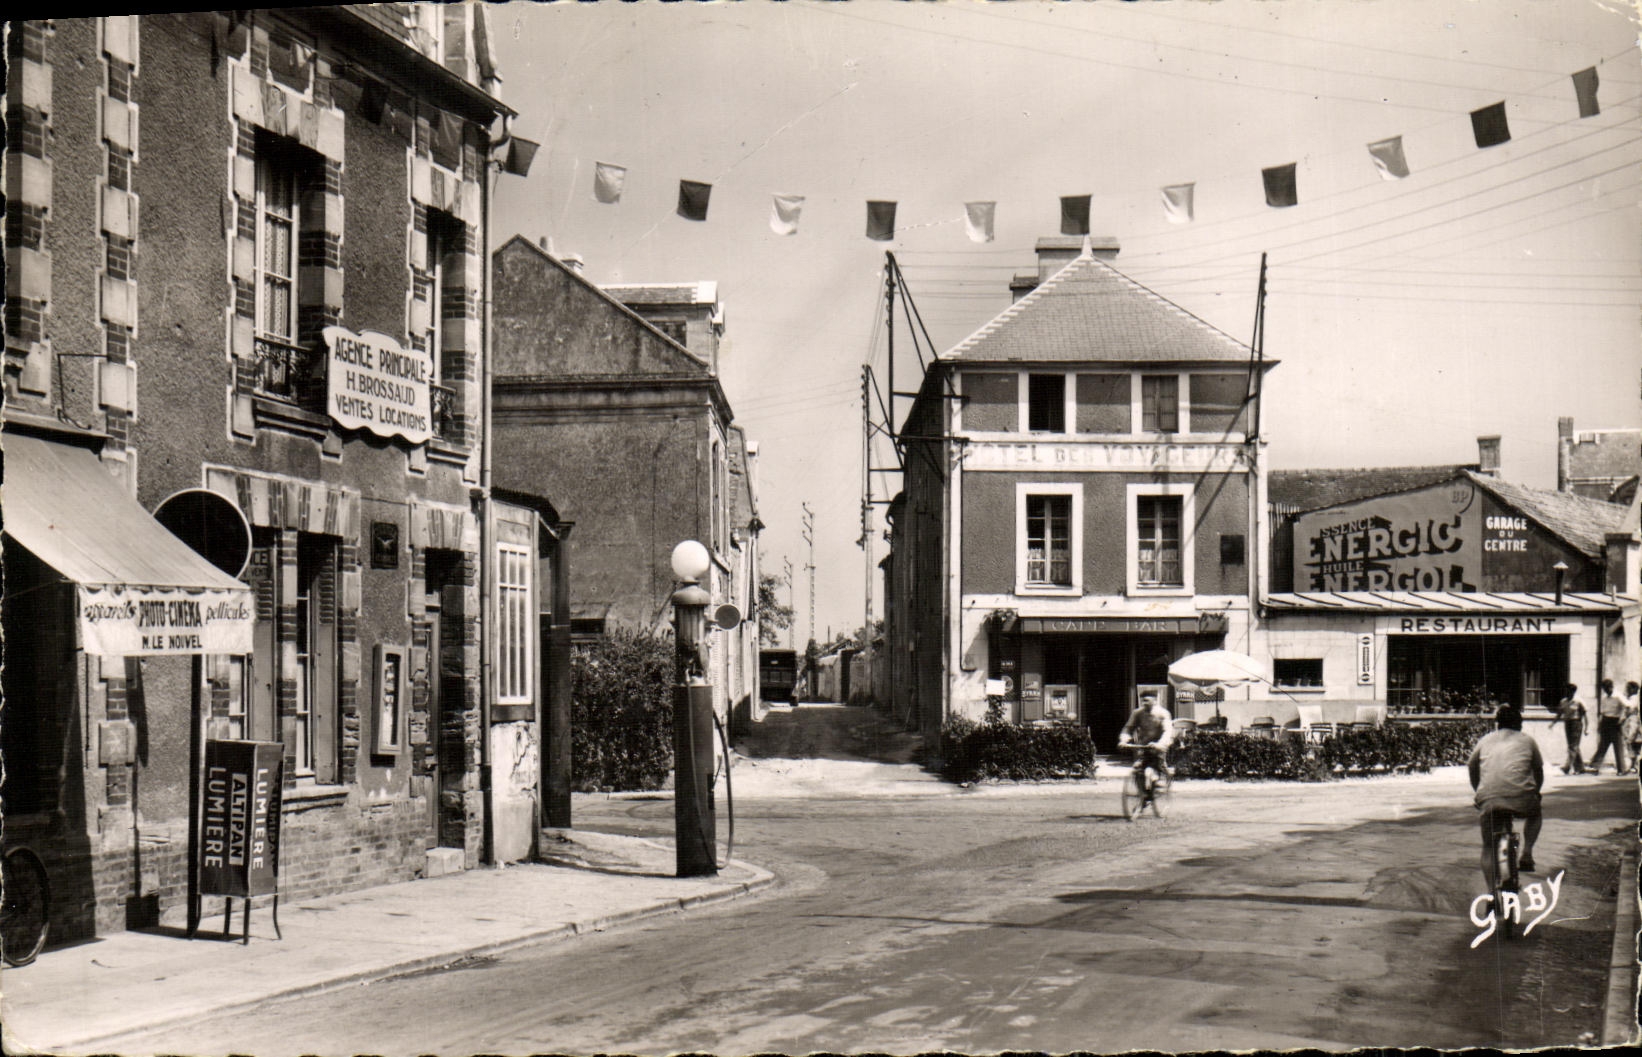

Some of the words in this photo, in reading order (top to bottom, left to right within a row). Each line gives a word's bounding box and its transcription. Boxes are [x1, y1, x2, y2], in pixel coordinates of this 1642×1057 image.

[335, 336, 373, 369] AGENCE
[379, 348, 426, 384] PRINCIPALE
[335, 393, 374, 420] VENTES
[379, 404, 427, 433] LOCATIONS
[1485, 516, 1528, 530] GARAGE
[1499, 530, 1514, 539] DU
[1304, 514, 1463, 563] ENERGIC
[1484, 539, 1528, 552] CENTRE
[1304, 564, 1464, 592] ENERGOL
[1323, 560, 1364, 575] HUILE
[205, 601, 250, 624] pellicules
[1125, 620, 1169, 632] BAR
[1401, 617, 1557, 632] RESTAURANT
[169, 635, 203, 649] NOUVEL
[205, 766, 227, 869] LUMIERE
[231, 778, 246, 858] ALTIPAN
[252, 768, 268, 870] LUMIERE
